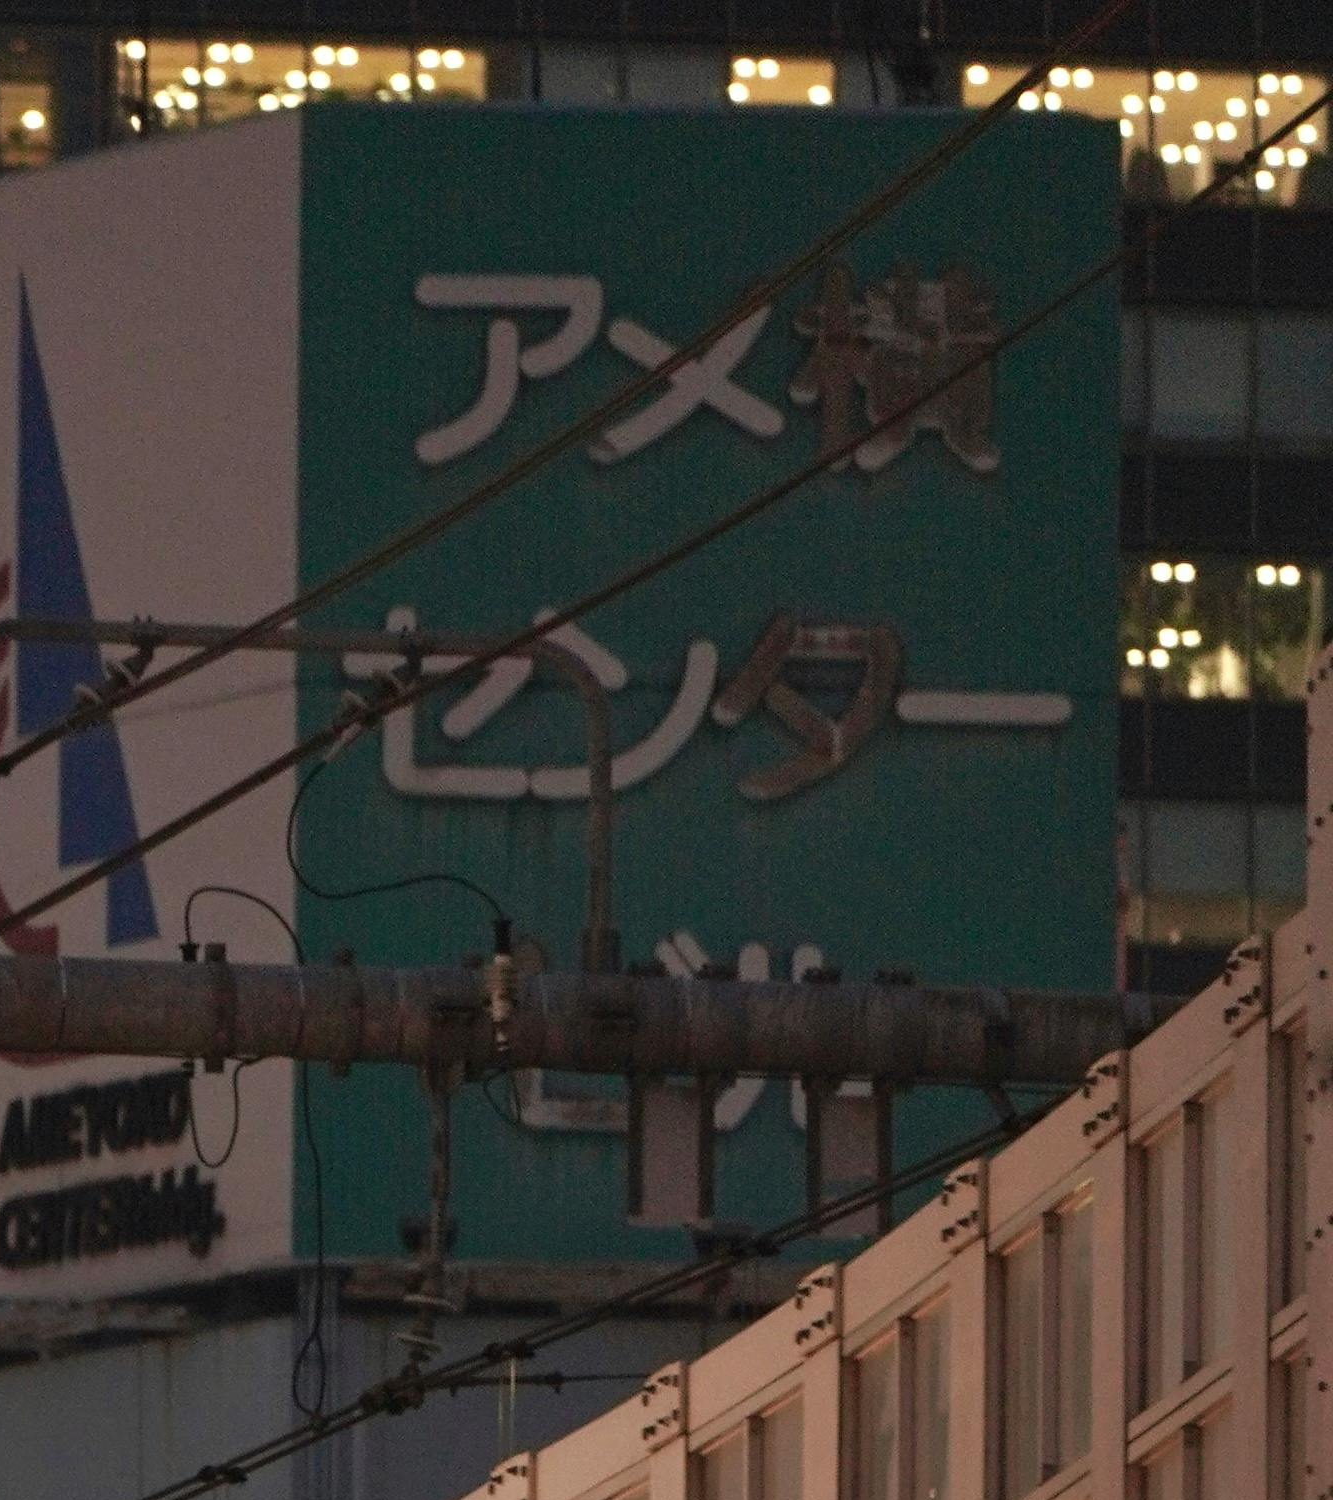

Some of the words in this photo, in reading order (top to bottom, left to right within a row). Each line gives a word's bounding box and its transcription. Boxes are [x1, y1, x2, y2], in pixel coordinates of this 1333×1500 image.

[413, 262, 1000, 476] アメ横
[341, 608, 1073, 800] センター
